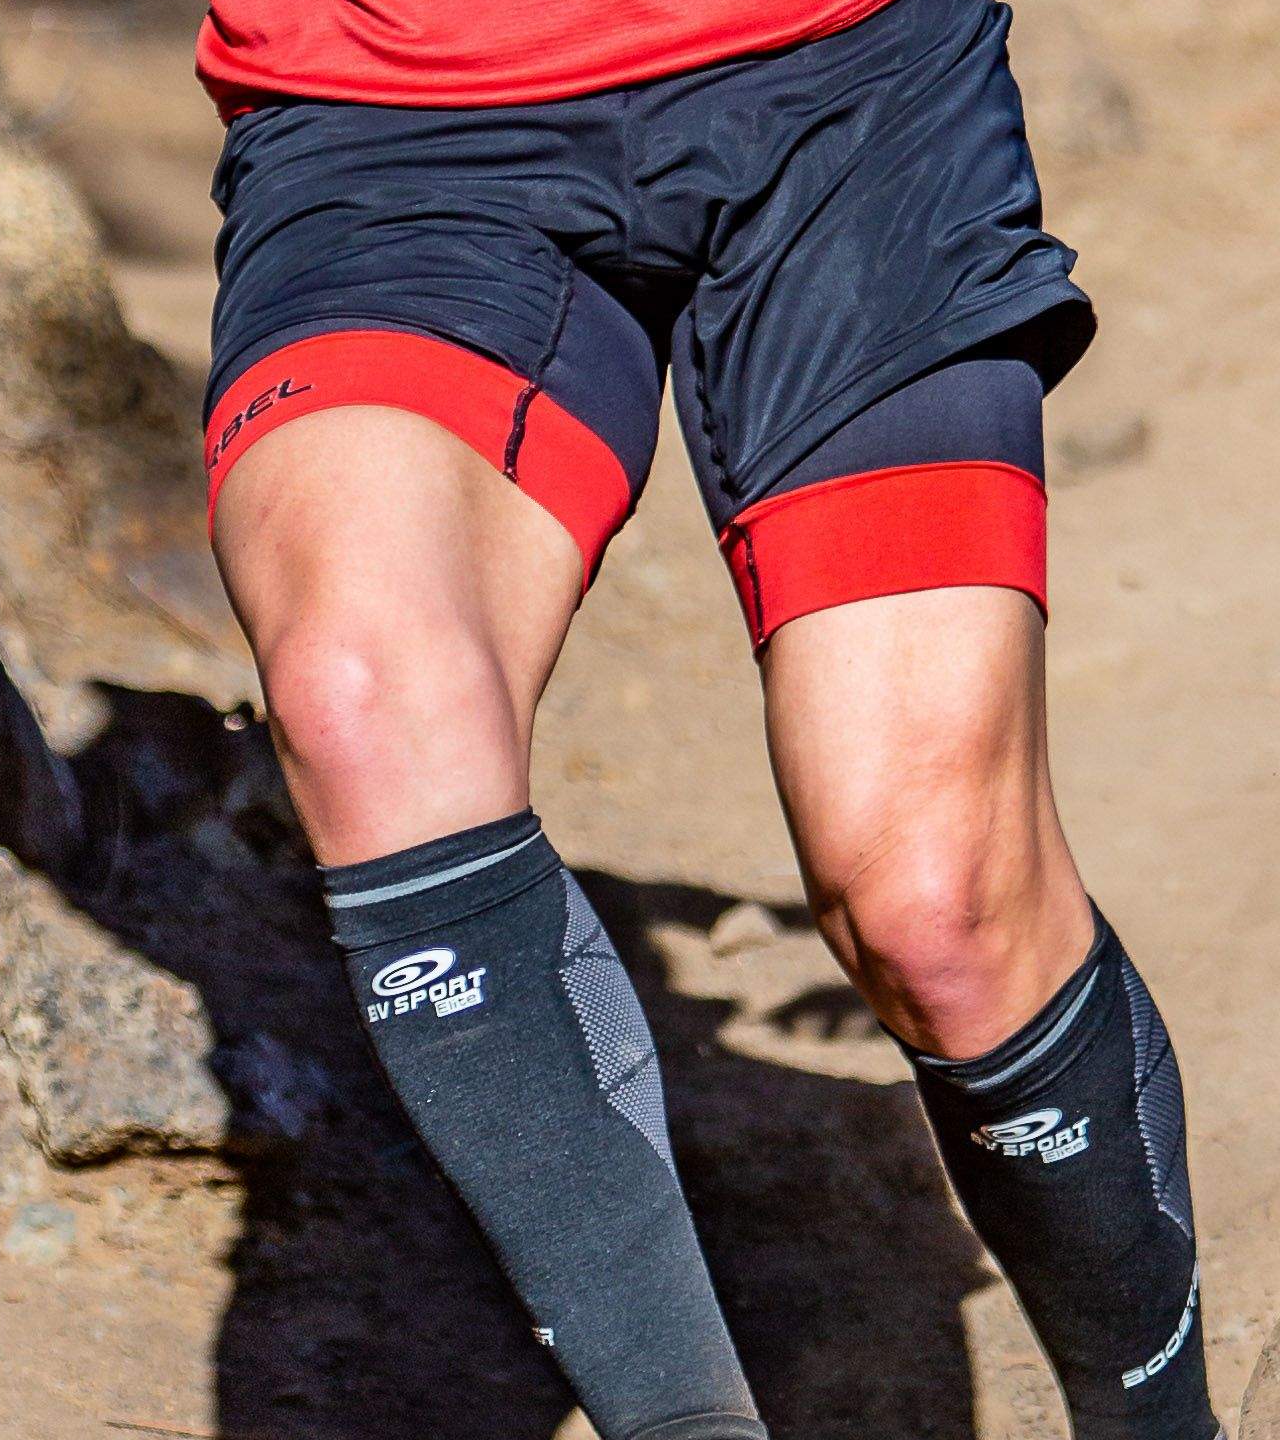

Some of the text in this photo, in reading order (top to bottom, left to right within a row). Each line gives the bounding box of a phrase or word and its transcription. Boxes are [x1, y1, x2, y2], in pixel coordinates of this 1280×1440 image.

[367, 967, 487, 1023] BV SPORT
[436, 992, 479, 1016] Elite
[1002, 1116, 1090, 1156] SPORT
